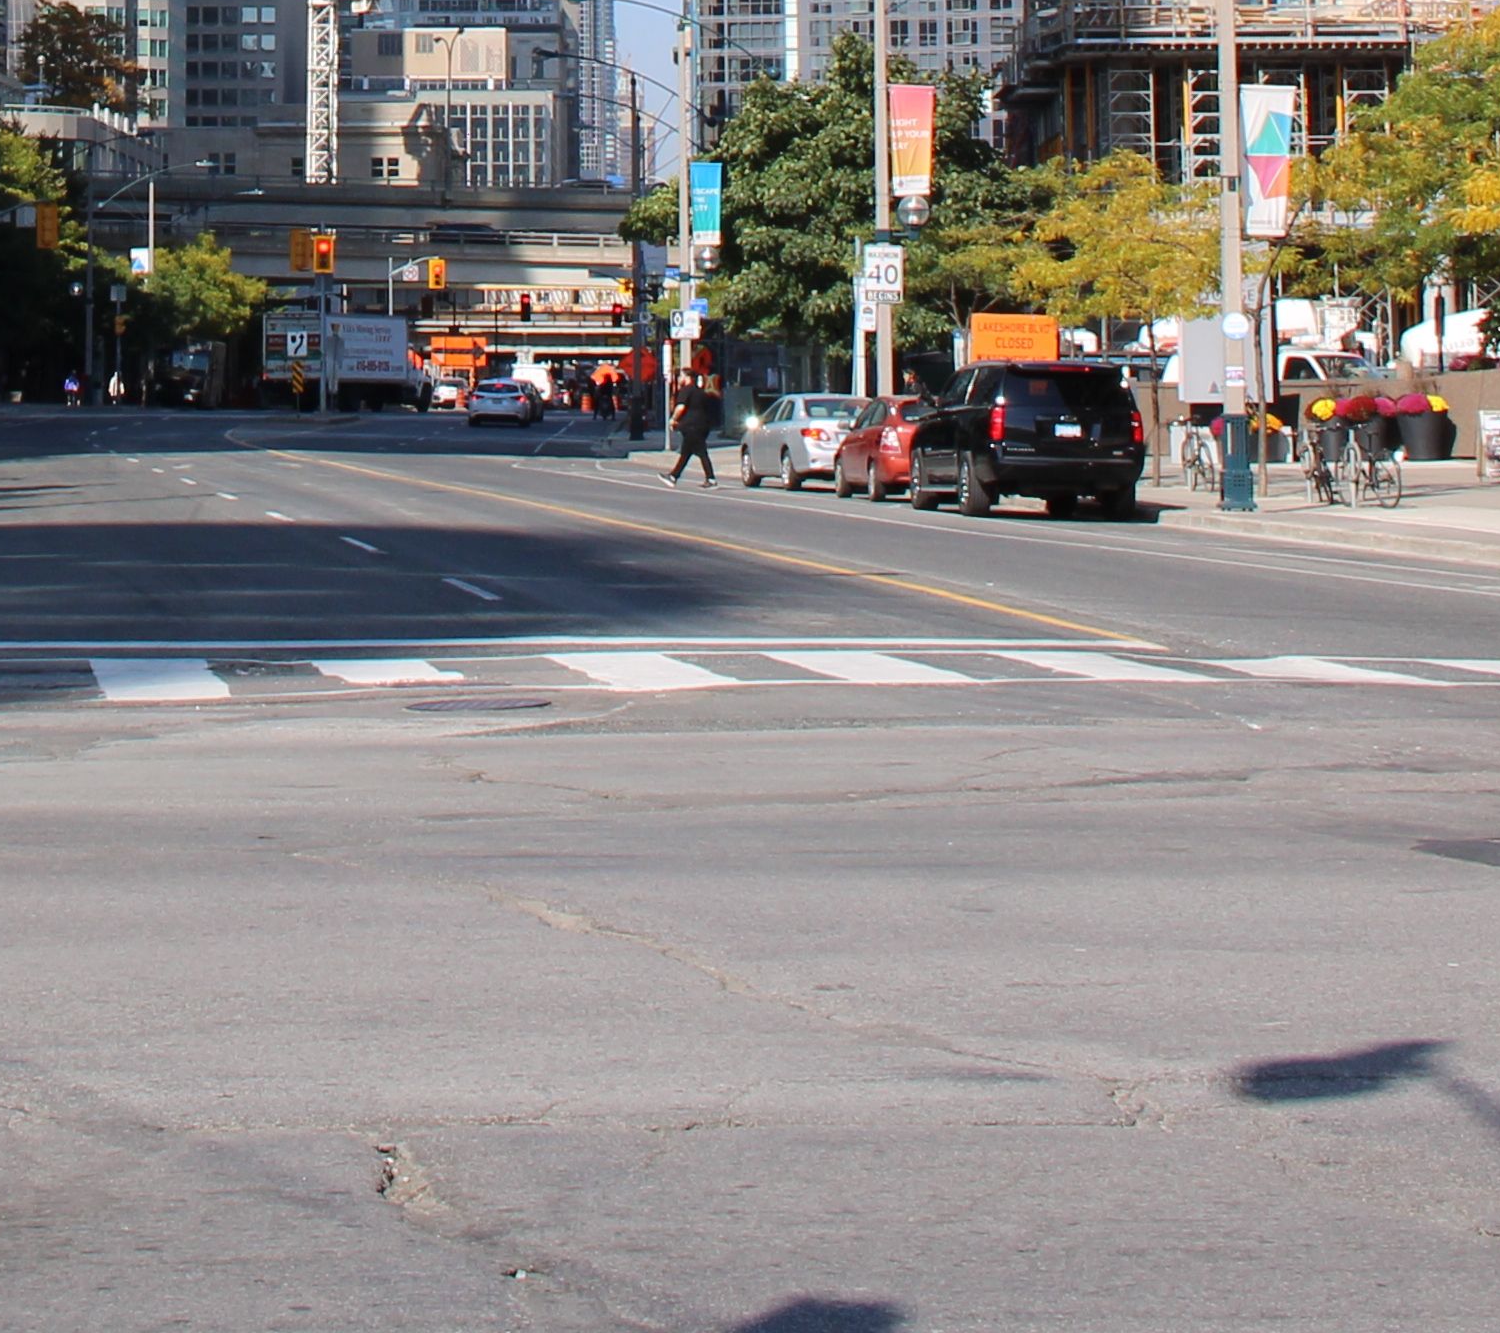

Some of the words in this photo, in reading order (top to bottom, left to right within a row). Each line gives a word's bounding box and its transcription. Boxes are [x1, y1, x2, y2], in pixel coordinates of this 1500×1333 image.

[867, 264, 898, 284] 40
[867, 292, 899, 301] BEGINS
[977, 322, 1026, 333] LAKESHORE
[995, 337, 1034, 349] CLOSED
